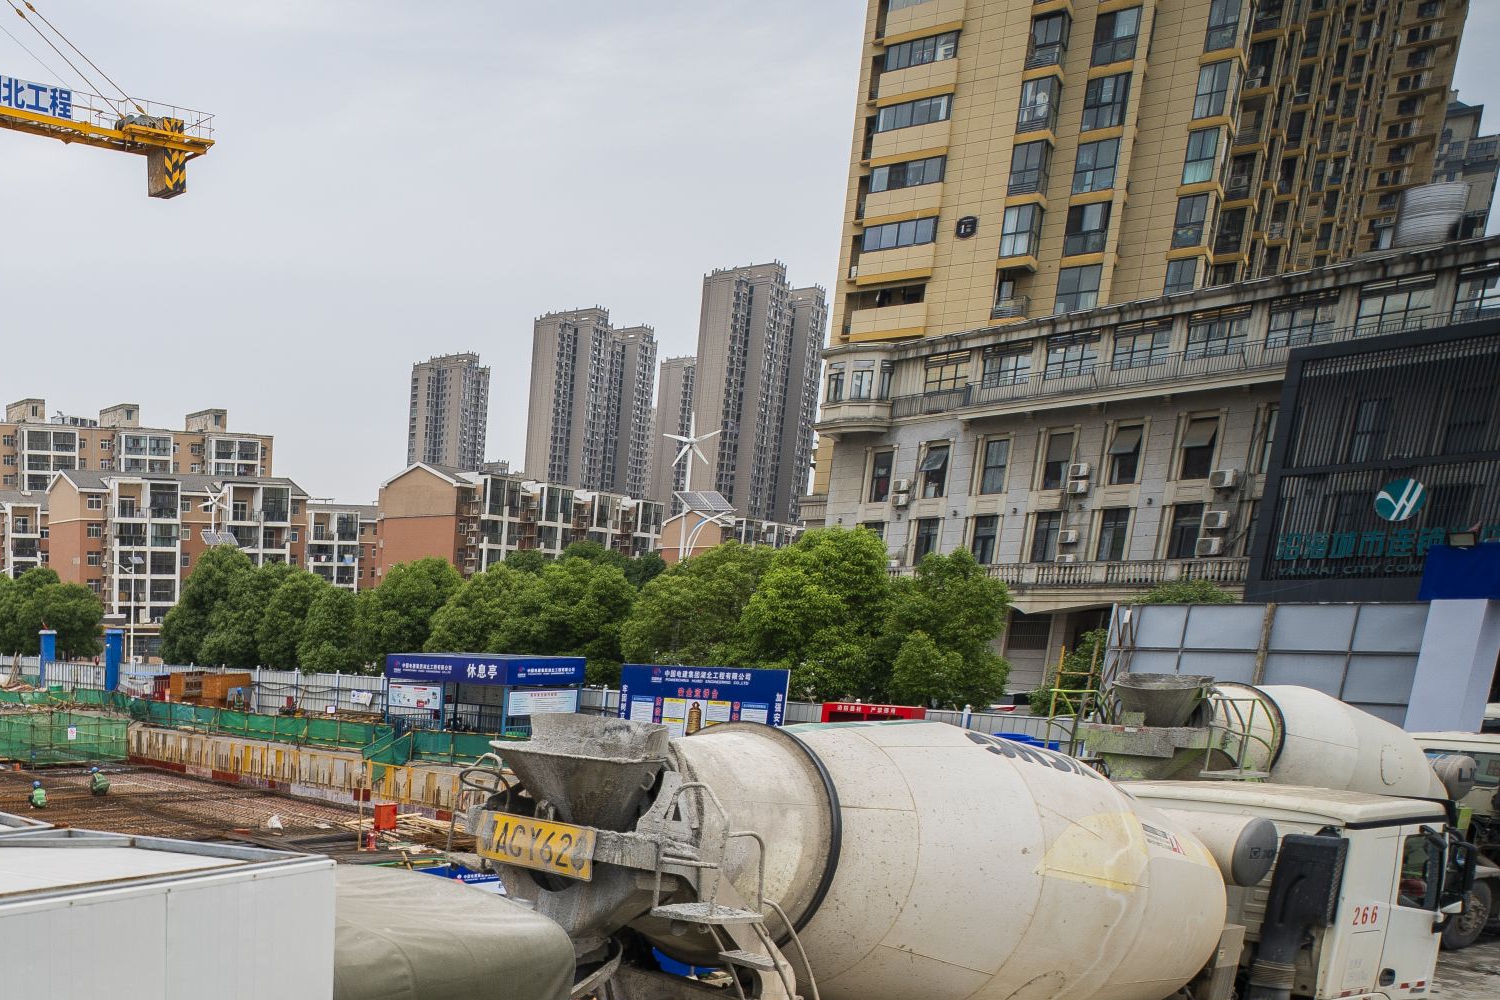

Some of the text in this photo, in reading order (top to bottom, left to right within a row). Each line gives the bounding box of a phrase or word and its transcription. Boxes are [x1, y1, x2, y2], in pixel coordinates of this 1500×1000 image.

[1278, 566, 1335, 577] YANHAI
[1343, 564, 1381, 575] CITY
[466, 663, 498, 680] 休息亭
[664, 670, 752, 681] 中国电建集团湖北工程有限公司
[1352, 905, 1379, 926] 266
